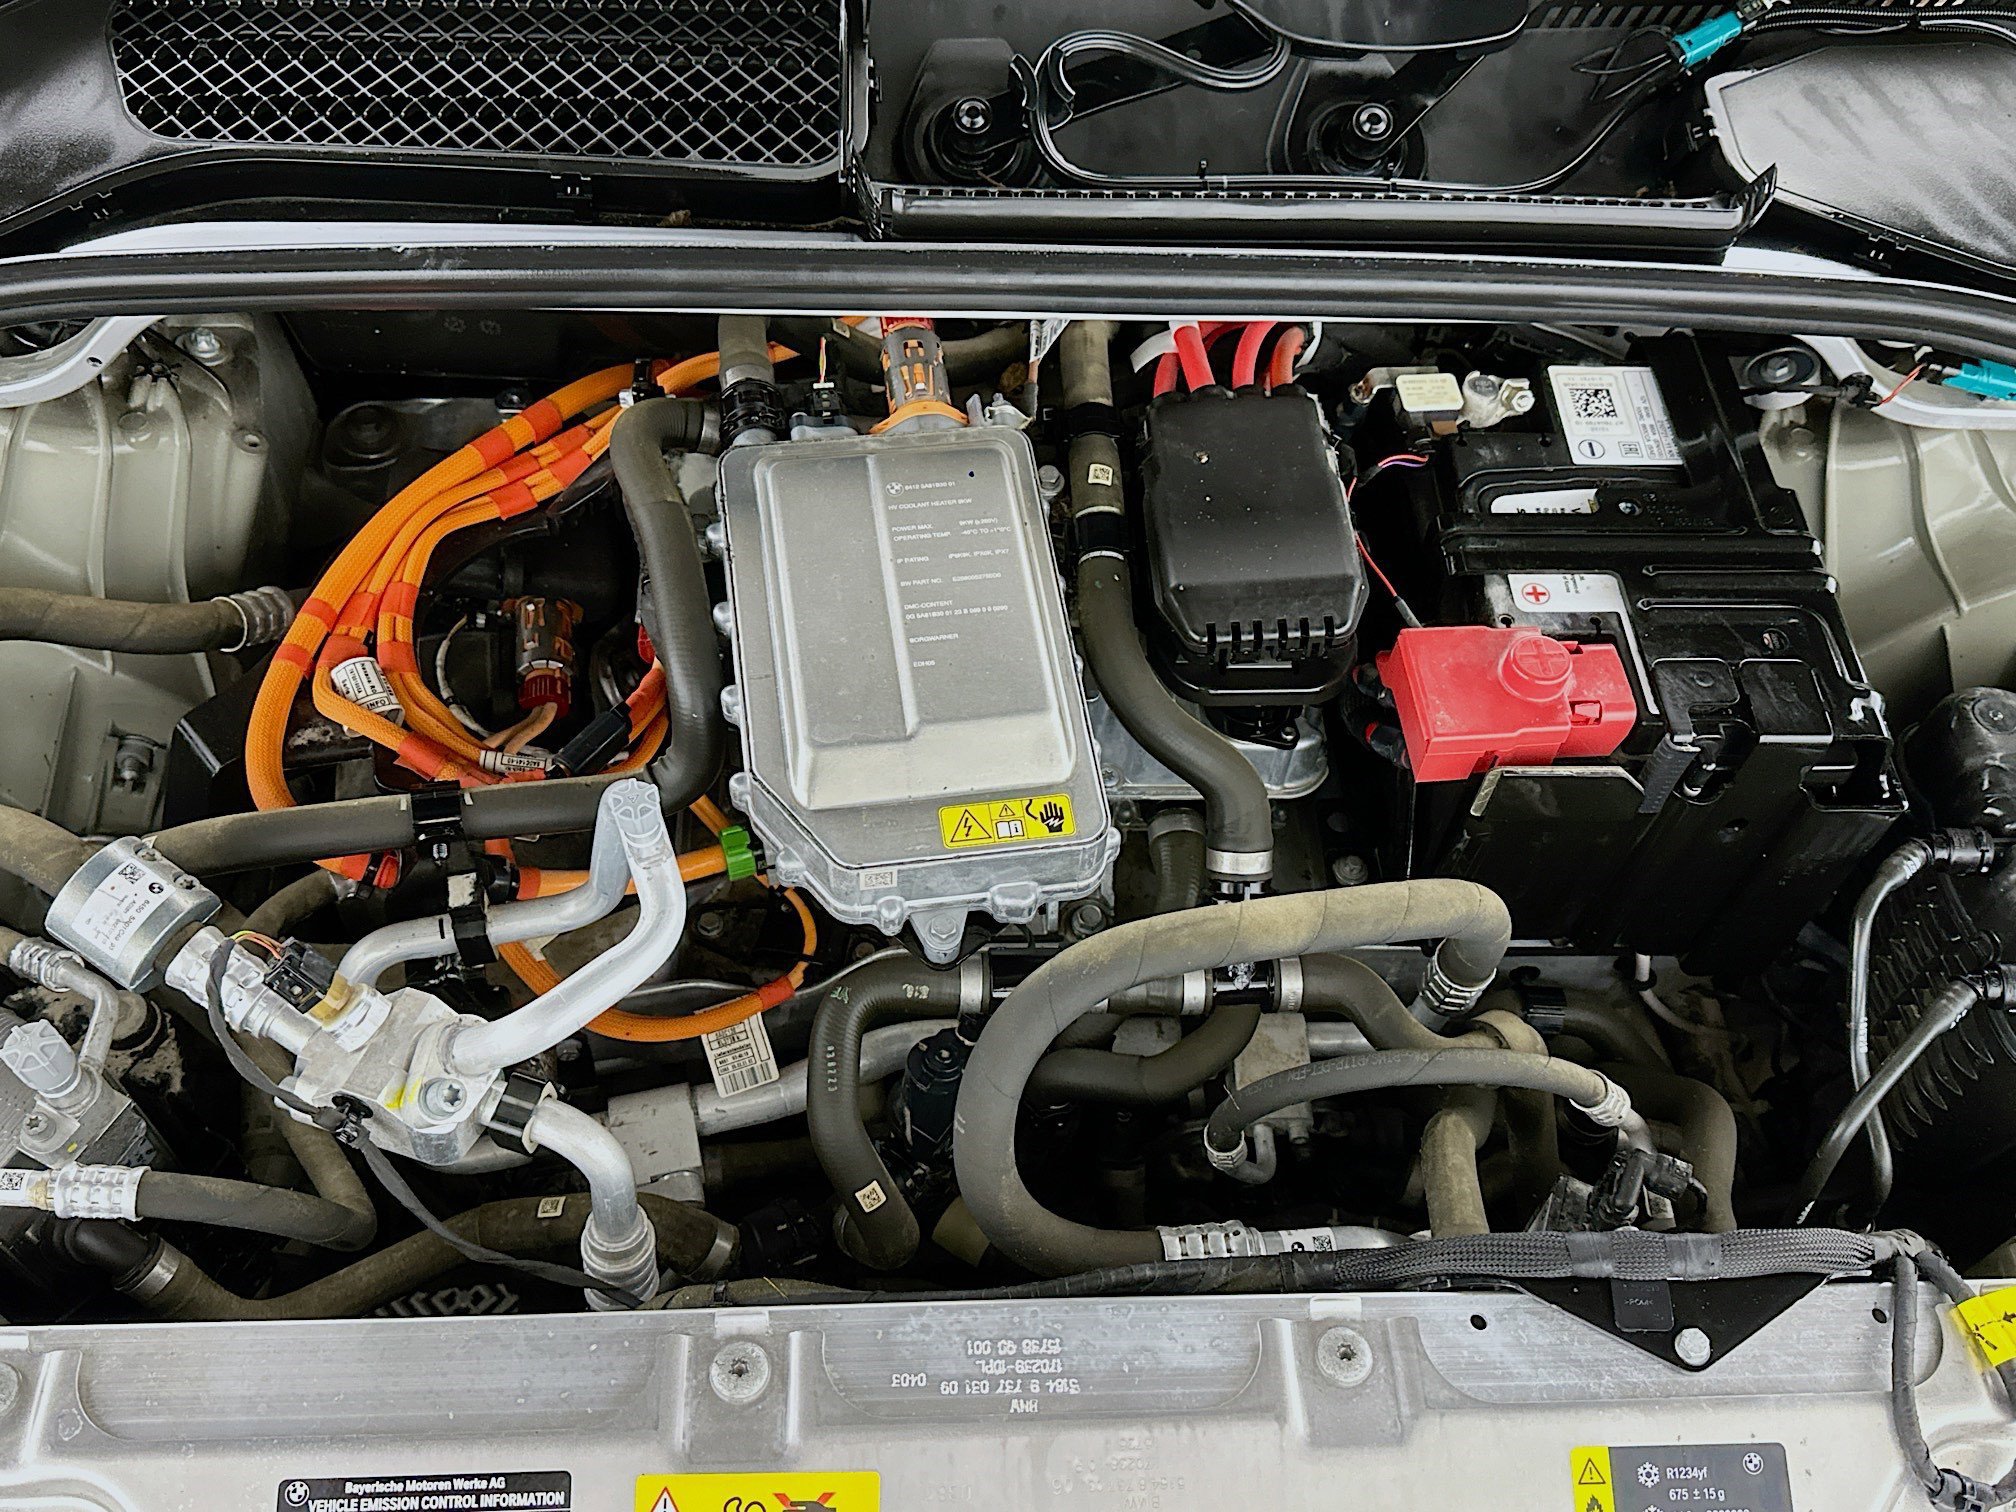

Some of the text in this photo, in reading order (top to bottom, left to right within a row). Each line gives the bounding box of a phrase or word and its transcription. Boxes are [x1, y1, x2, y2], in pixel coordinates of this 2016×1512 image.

[898, 501, 930, 509] COOLANT
[930, 499, 957, 507] HEATER
[893, 532, 932, 541] OPERATING
[903, 600, 953, 610] DMC-CONTENT
[909, 633, 959, 643] BORGWARNER
[366, 699, 386, 709] INFO
[889, 1372, 927, 1388] 0403
[939, 1379, 959, 1394] 09
[963, 1379, 989, 1394] 031
[995, 1378, 1022, 1394] 737
[1008, 1397, 1038, 1413] BMW
[1666, 1467, 1708, 1481] R1234yf
[345, 1476, 506, 1495] Bayerische Motoren Werke AG
[1668, 1488, 1689, 1500] 675
[308, 1491, 565, 1512] VEHICLE EMISSION CONTROL INFORMATION
